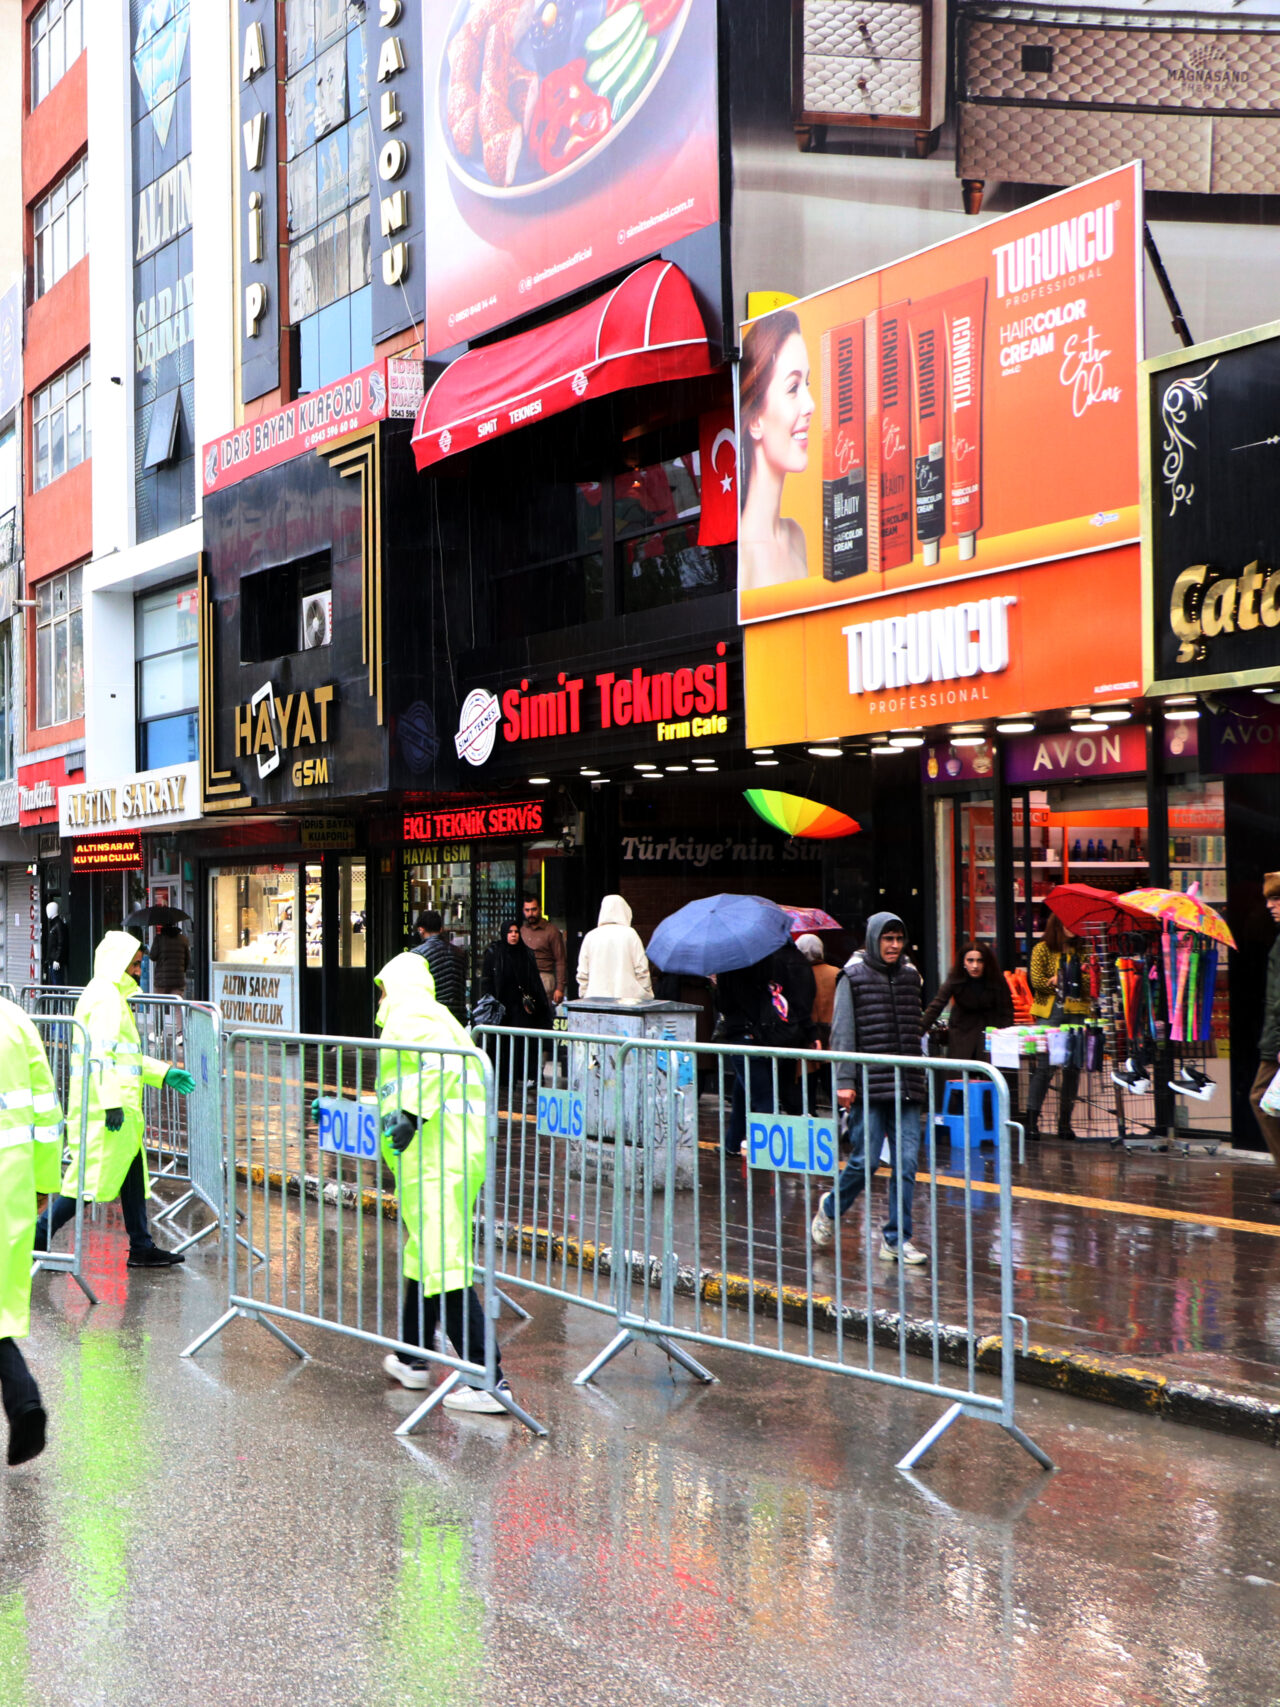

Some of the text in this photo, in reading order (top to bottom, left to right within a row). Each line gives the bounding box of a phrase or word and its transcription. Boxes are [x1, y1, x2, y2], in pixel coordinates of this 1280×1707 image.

[992, 202, 1114, 299] TURUNCU
[1005, 266, 1102, 309] PROFESSIONAL
[1000, 299, 1087, 345] HAIRCOLOR
[951, 316, 971, 414] TURUNCU
[1000, 332, 1055, 367] CREAM
[221, 377, 363, 470] İDRİS BAYAN KUAFÖRÜ
[842, 596, 1010, 696] TURUNCU
[235, 684, 334, 758] HAYAT
[869, 686, 990, 715] PROFESSIONAL
[692, 714, 728, 738] Cafe
[1221, 724, 1280, 745] AVO
[292, 757, 329, 787] GSM
[1032, 734, 1121, 772] AVON
[66, 774, 187, 827] ALTIN SARAY
[434, 808, 487, 838] TEKNİK
[488, 803, 543, 834] SERVİS
[403, 844, 471, 865] HAYAT GSM
[222, 974, 281, 999] ALTIN SARAY
[221, 999, 284, 1026] KUYUMCULUK
[319, 1105, 376, 1156] POLİS
[537, 1092, 583, 1137] POLİS
[750, 1119, 833, 1172] POLİS
